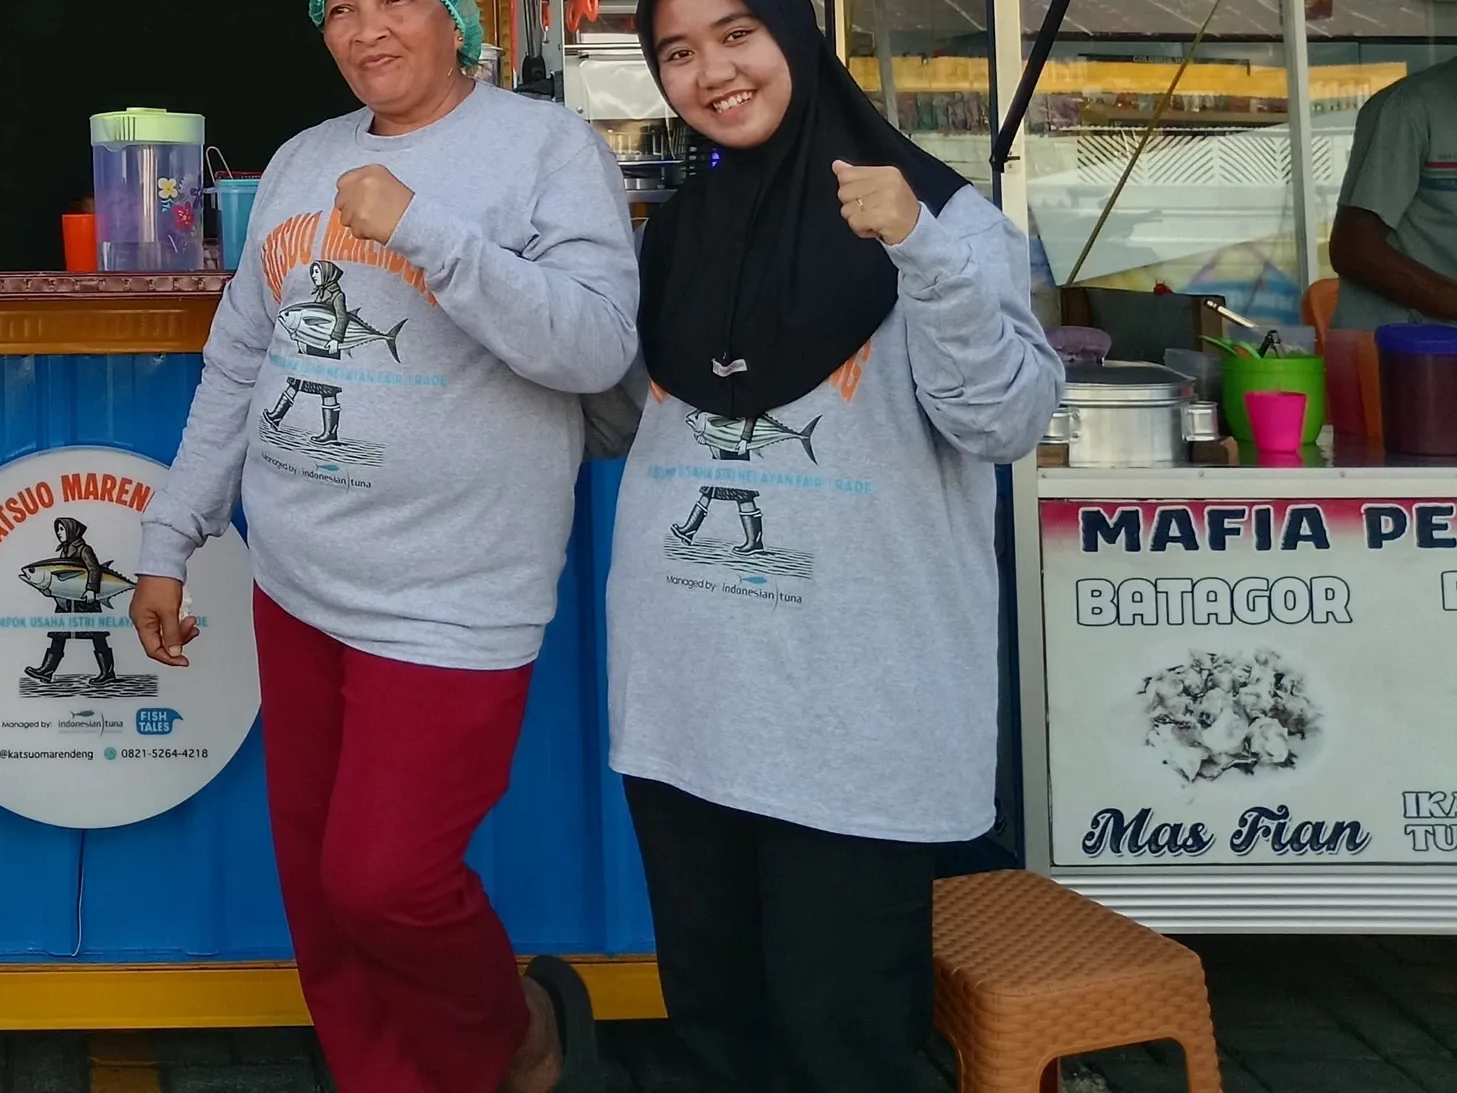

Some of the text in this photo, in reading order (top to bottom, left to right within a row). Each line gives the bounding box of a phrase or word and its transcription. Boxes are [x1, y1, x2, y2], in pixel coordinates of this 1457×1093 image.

[350, 477, 372, 488] tuna
[1078, 504, 1331, 553] MAFIA
[666, 574, 704, 590] Managed
[722, 583, 775, 599] indonesian
[780, 590, 803, 603] tuna
[1076, 575, 1353, 626] BATAGOR
[30, 617, 65, 628] USAHA
[69, 616, 95, 627] ISTRI
[140, 712, 167, 721] FISH
[2, 720, 40, 730] Managed
[58, 719, 101, 728] indonesian
[105, 720, 124, 728] tuna
[138, 722, 170, 732] TALES
[0, 748, 209, 760] @katsuomarendeng 0821-5264-4218
[1081, 803, 1372, 859] Mas Fian
